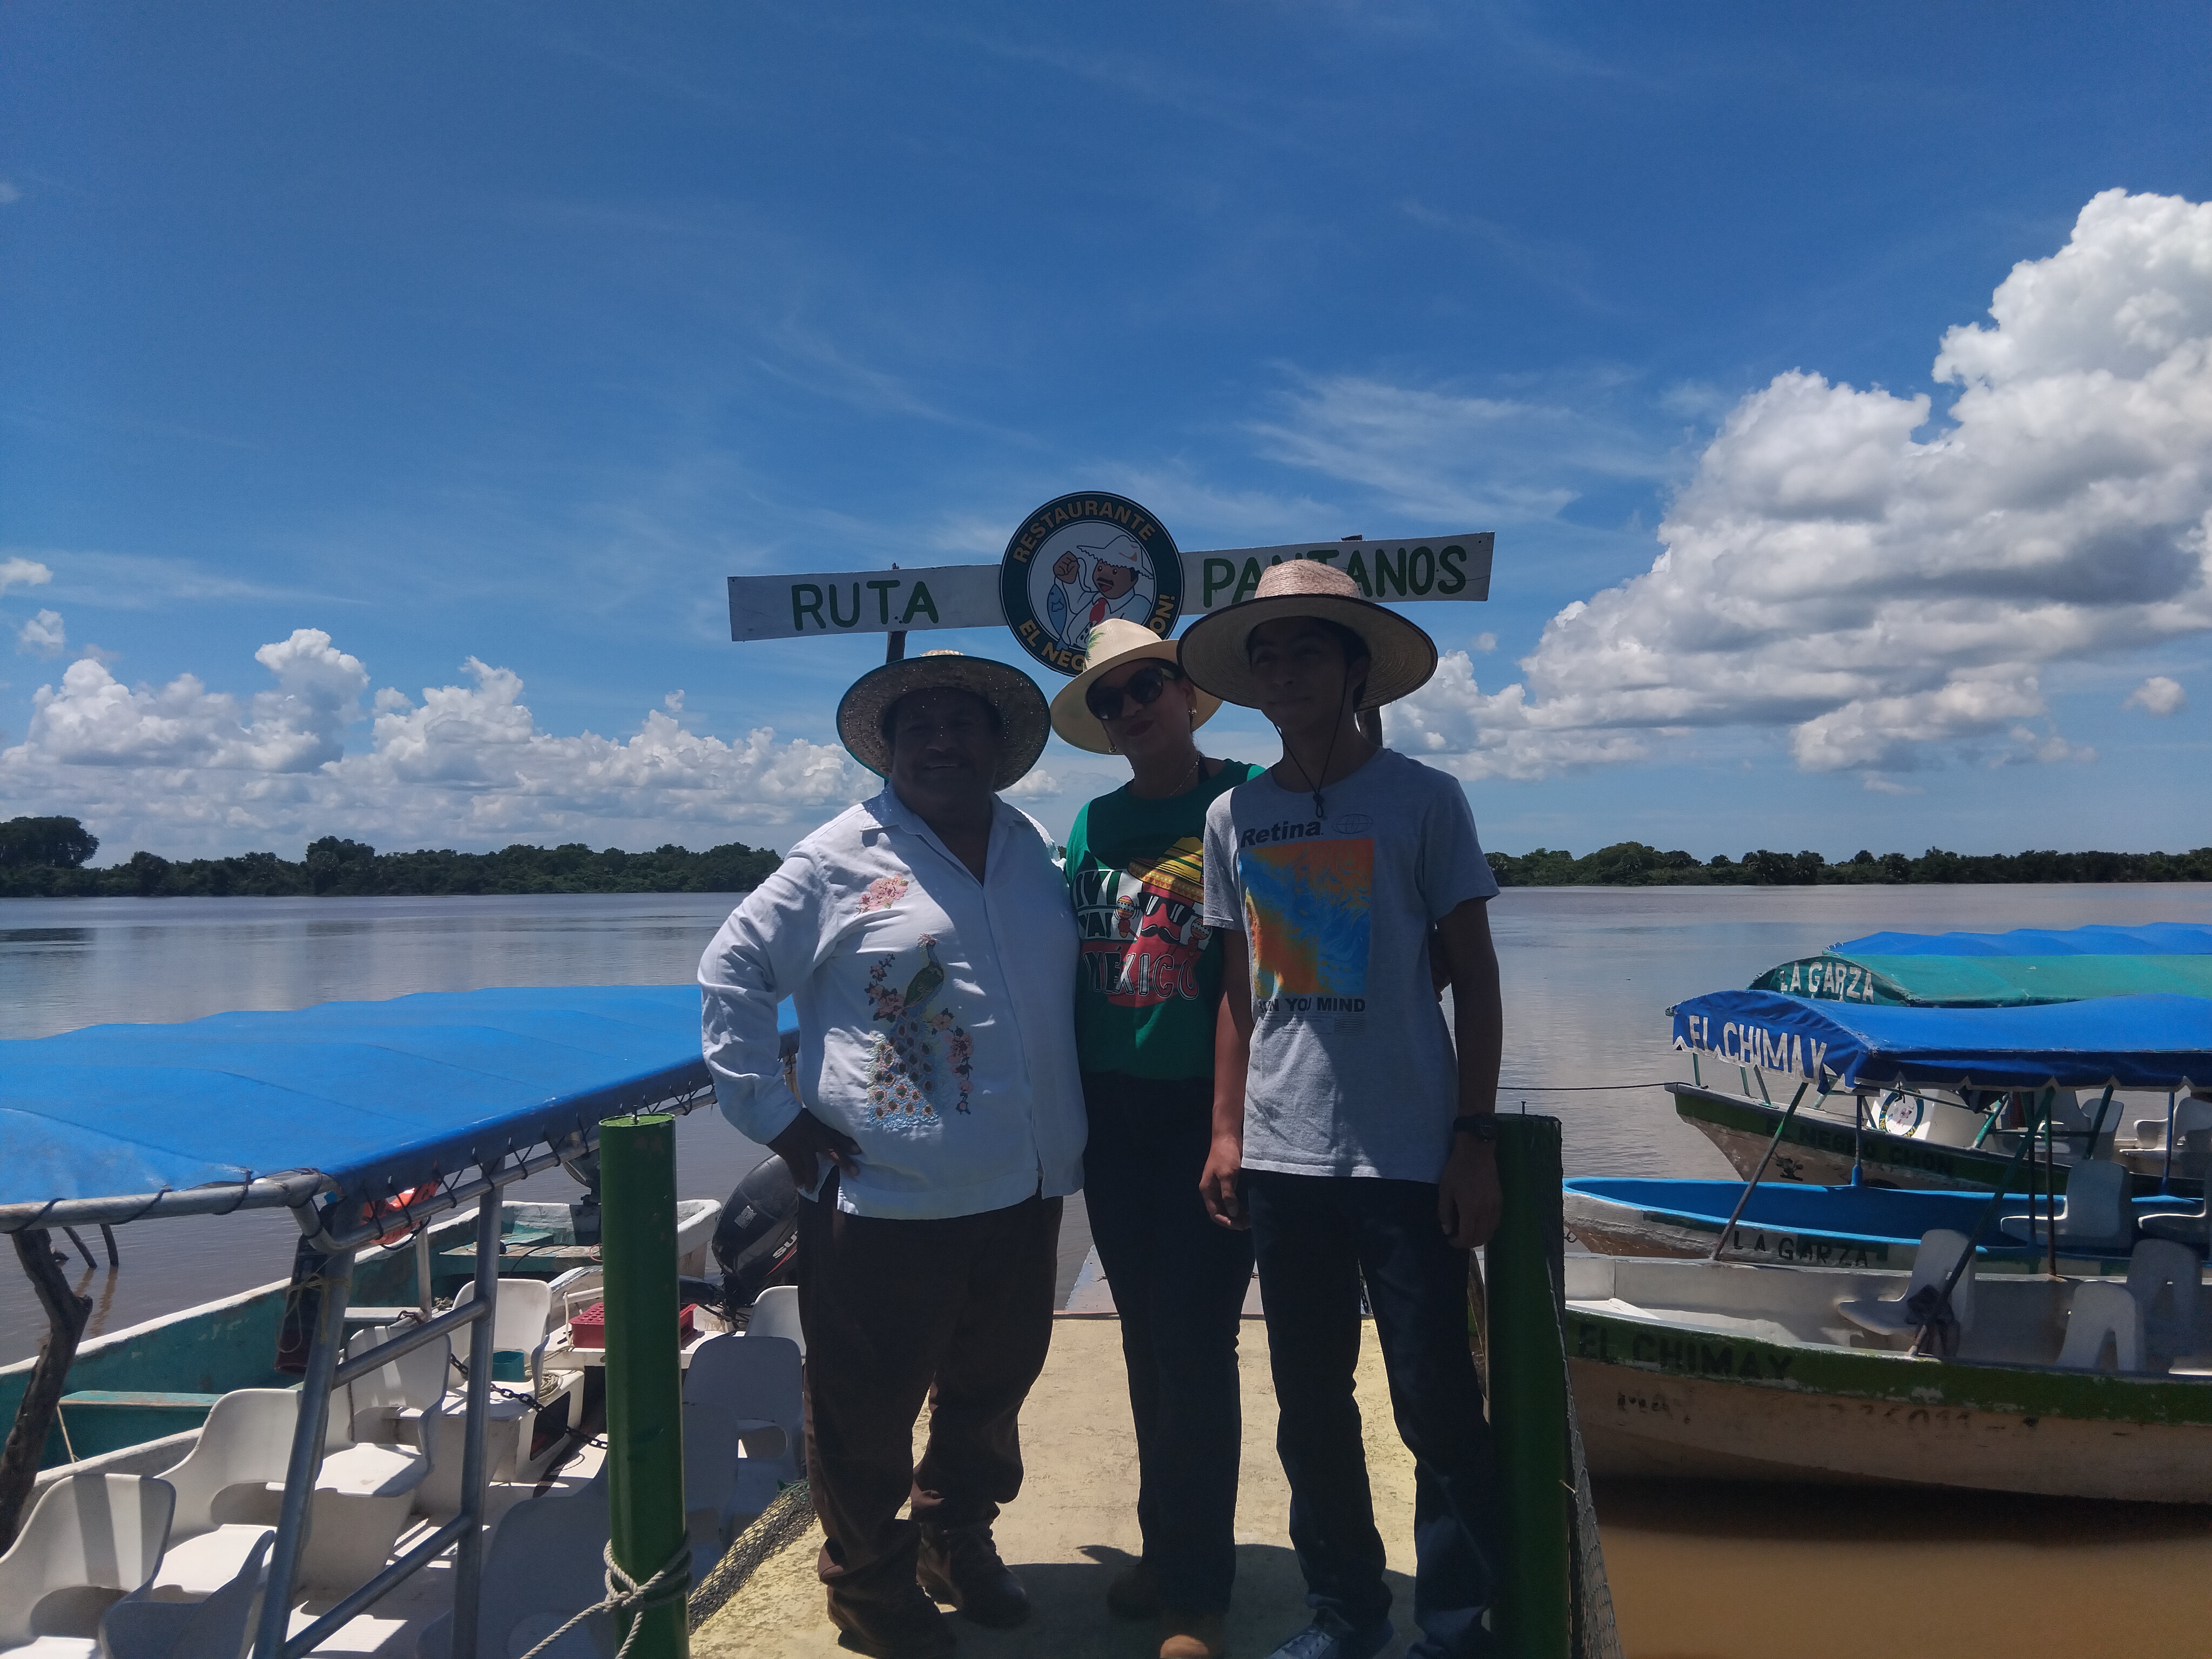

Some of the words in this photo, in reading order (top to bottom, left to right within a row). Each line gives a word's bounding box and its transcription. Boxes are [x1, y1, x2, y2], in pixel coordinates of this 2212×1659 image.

[1013, 500, 1156, 563] RESTAURANTE
[791, 579, 939, 631] RUTA
[1019, 619, 1038, 648] EL
[1041, 641, 1086, 671] NEG
[1317, 997, 1366, 1012] MIND
[1780, 962, 1802, 993] LA
[1808, 961, 1874, 1003] GARZA
[1689, 1015, 1713, 1051] EL
[1723, 1022, 1827, 1085] CHIMAY
[1733, 1230, 1766, 1252] LA
[1778, 1237, 1868, 1269] GARZA
[1579, 1323, 1617, 1364] EL
[1633, 1332, 1793, 1380] CHIMAY
